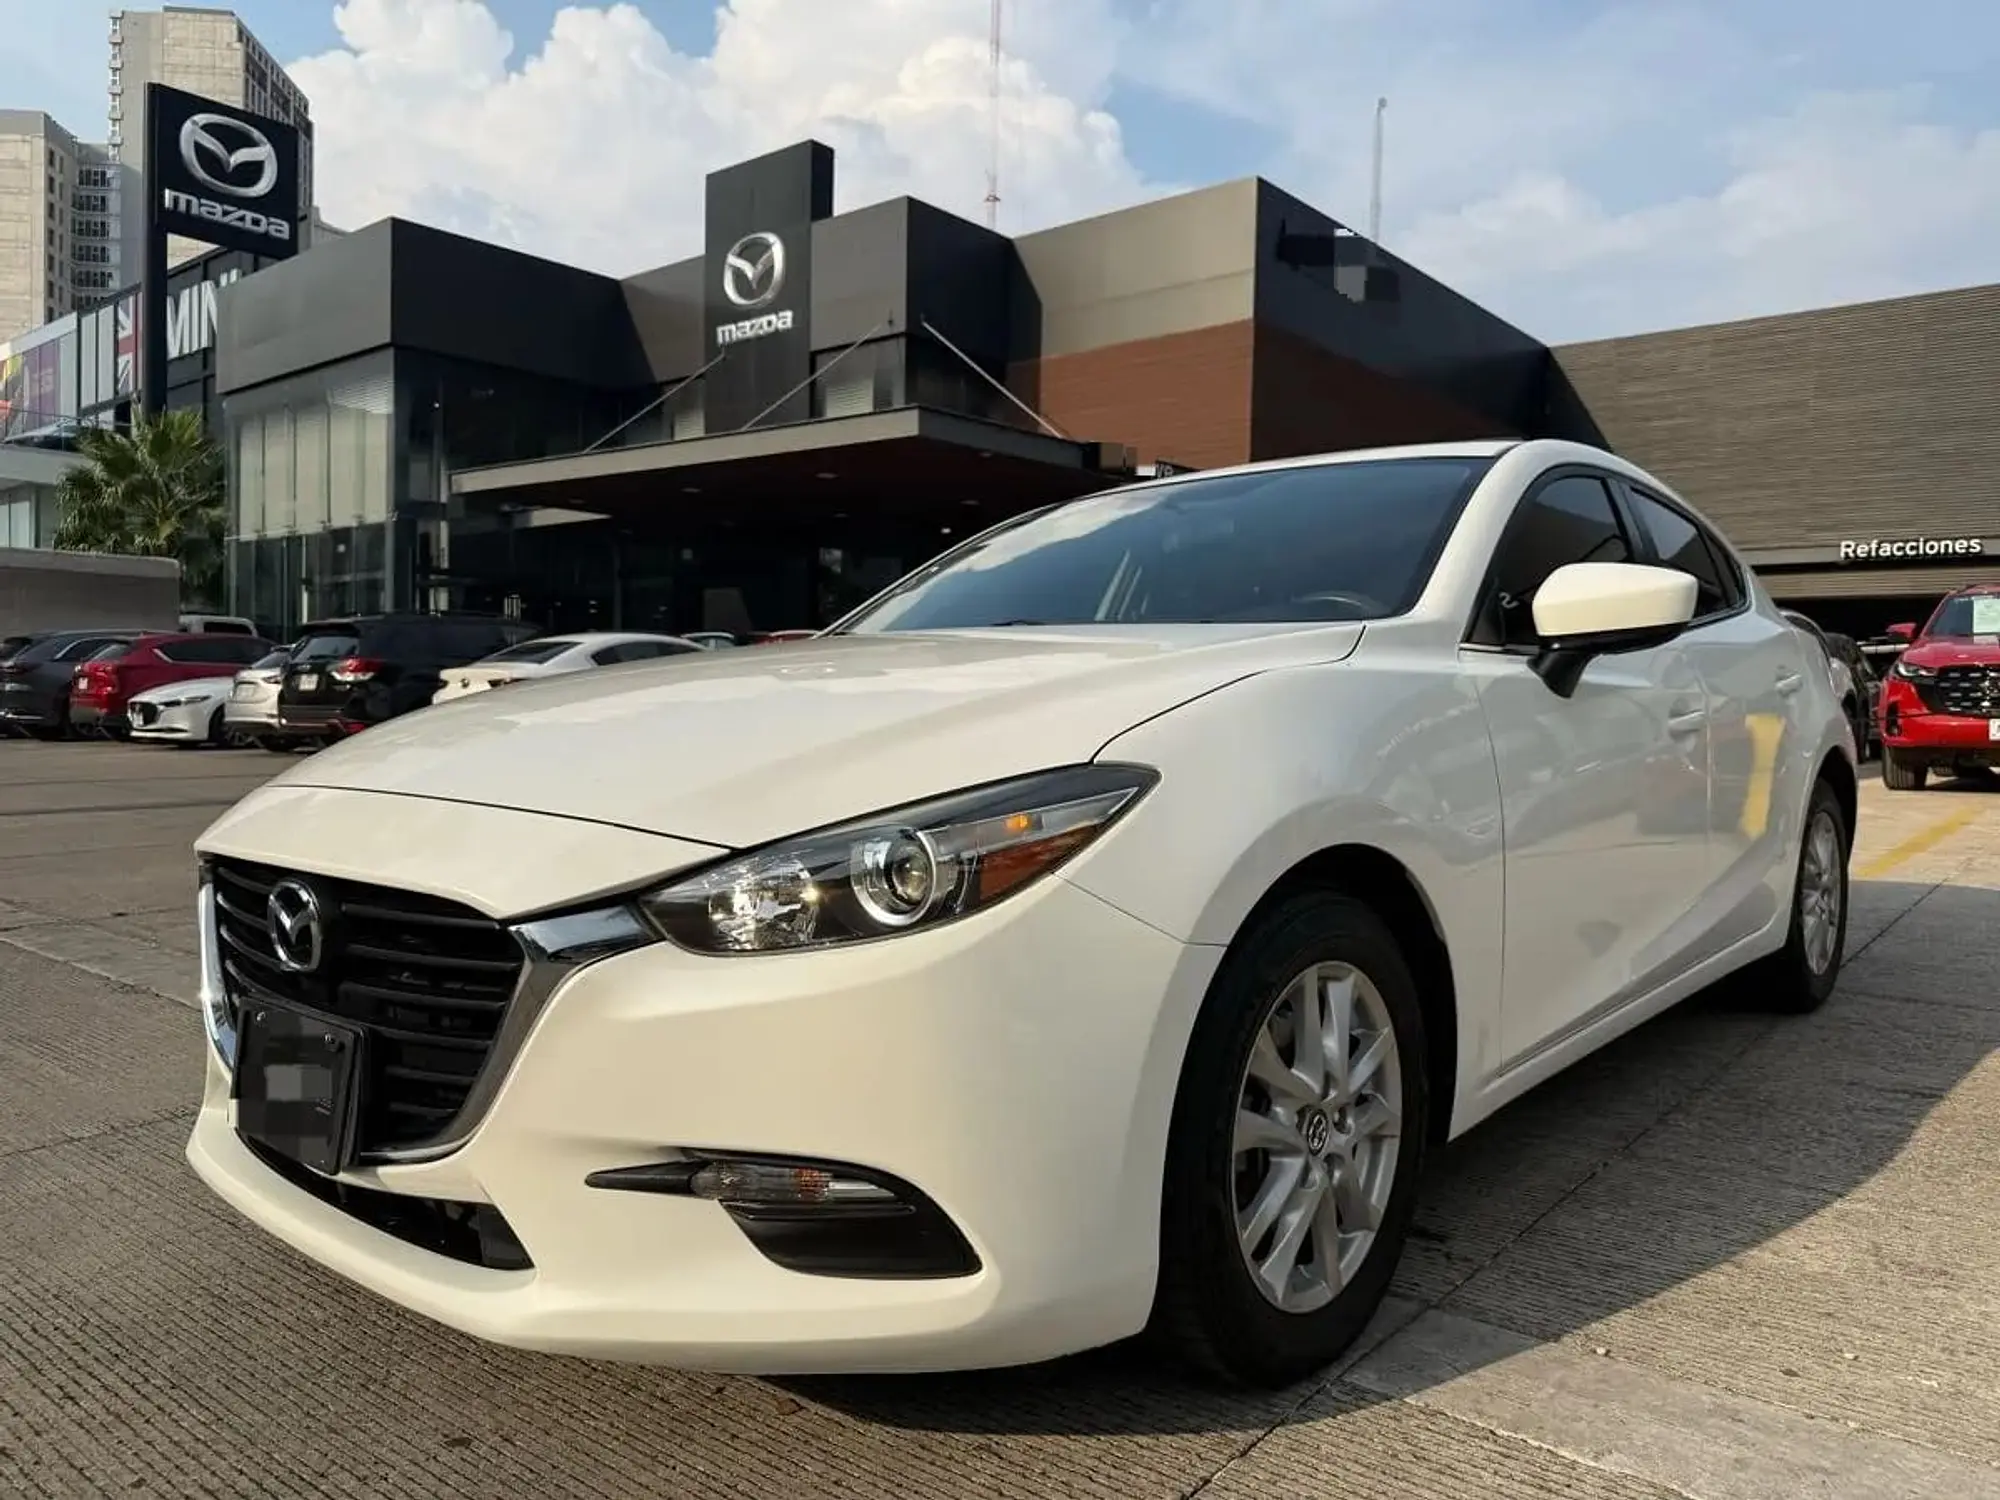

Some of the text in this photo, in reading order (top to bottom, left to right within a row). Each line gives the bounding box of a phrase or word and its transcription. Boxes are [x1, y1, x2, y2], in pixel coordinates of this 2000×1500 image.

[165, 188, 290, 240] mazda
[716, 309, 793, 345] mazda
[1839, 538, 1982, 559] Refacciones
